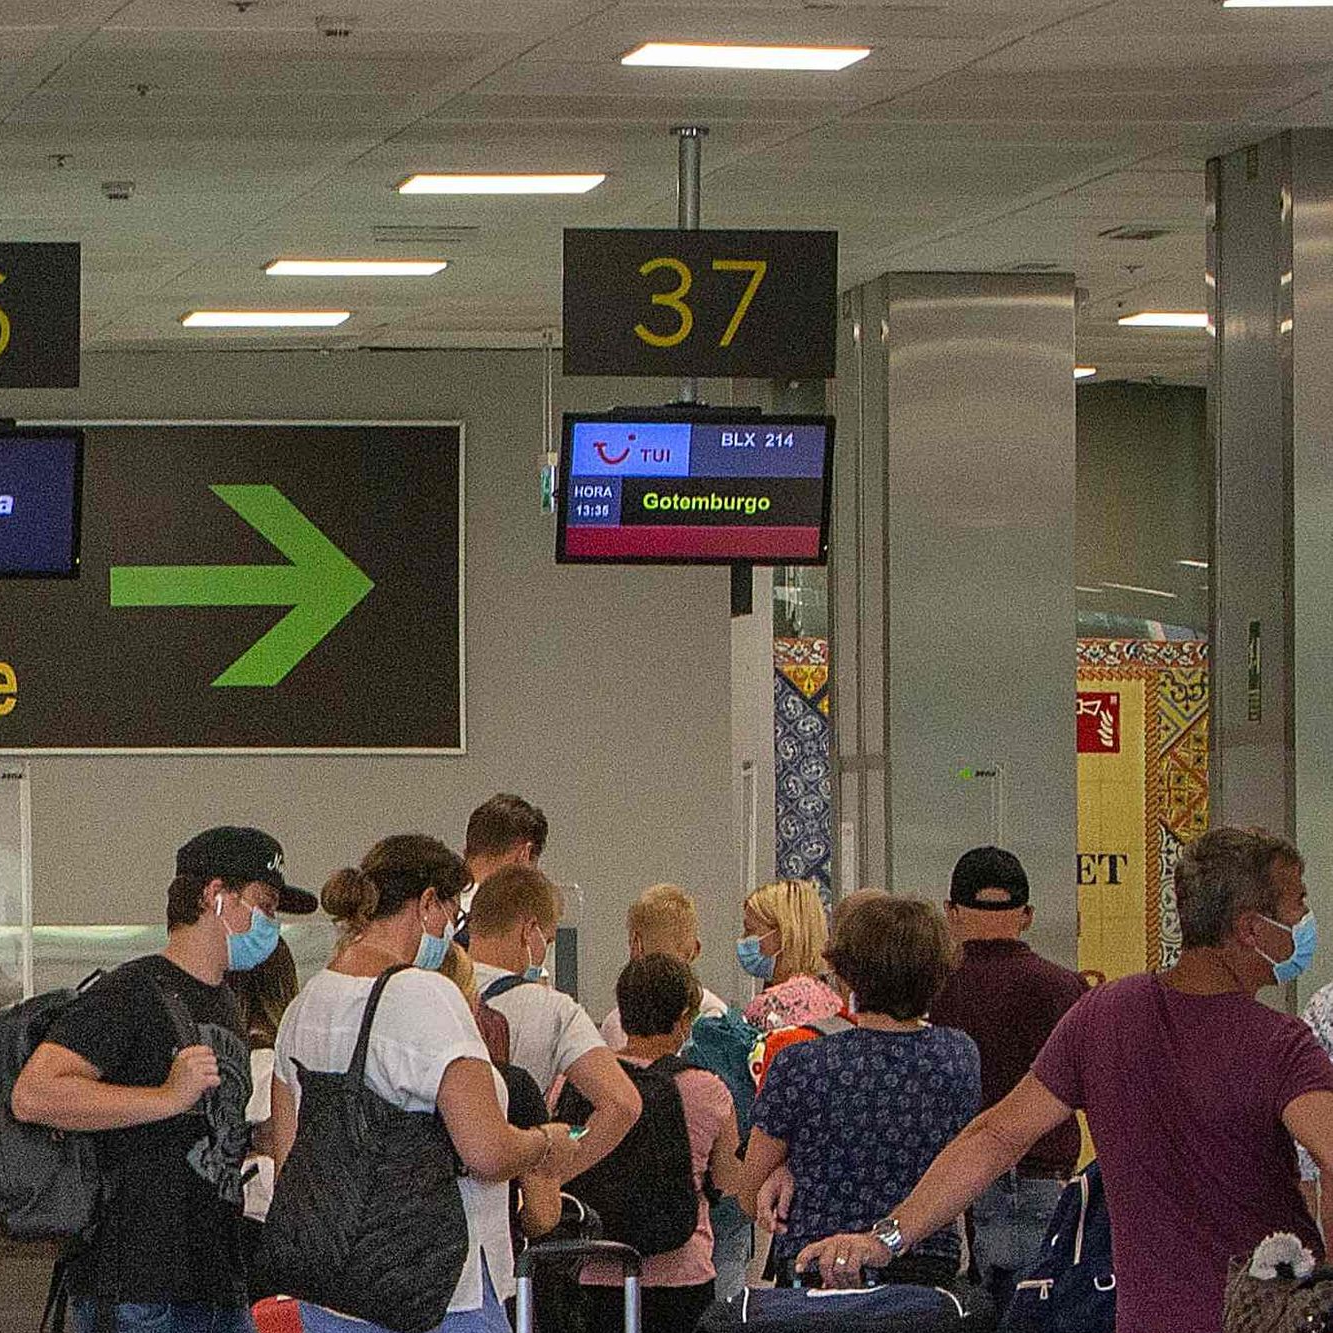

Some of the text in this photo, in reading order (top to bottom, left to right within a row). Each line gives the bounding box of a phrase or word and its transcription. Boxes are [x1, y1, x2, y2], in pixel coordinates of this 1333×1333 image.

[634, 257, 768, 348] 37
[721, 432, 794, 448] BLX 214
[640, 448, 671, 463] TUI
[574, 486, 613, 499] HORA
[642, 491, 771, 515] Gotemburgo
